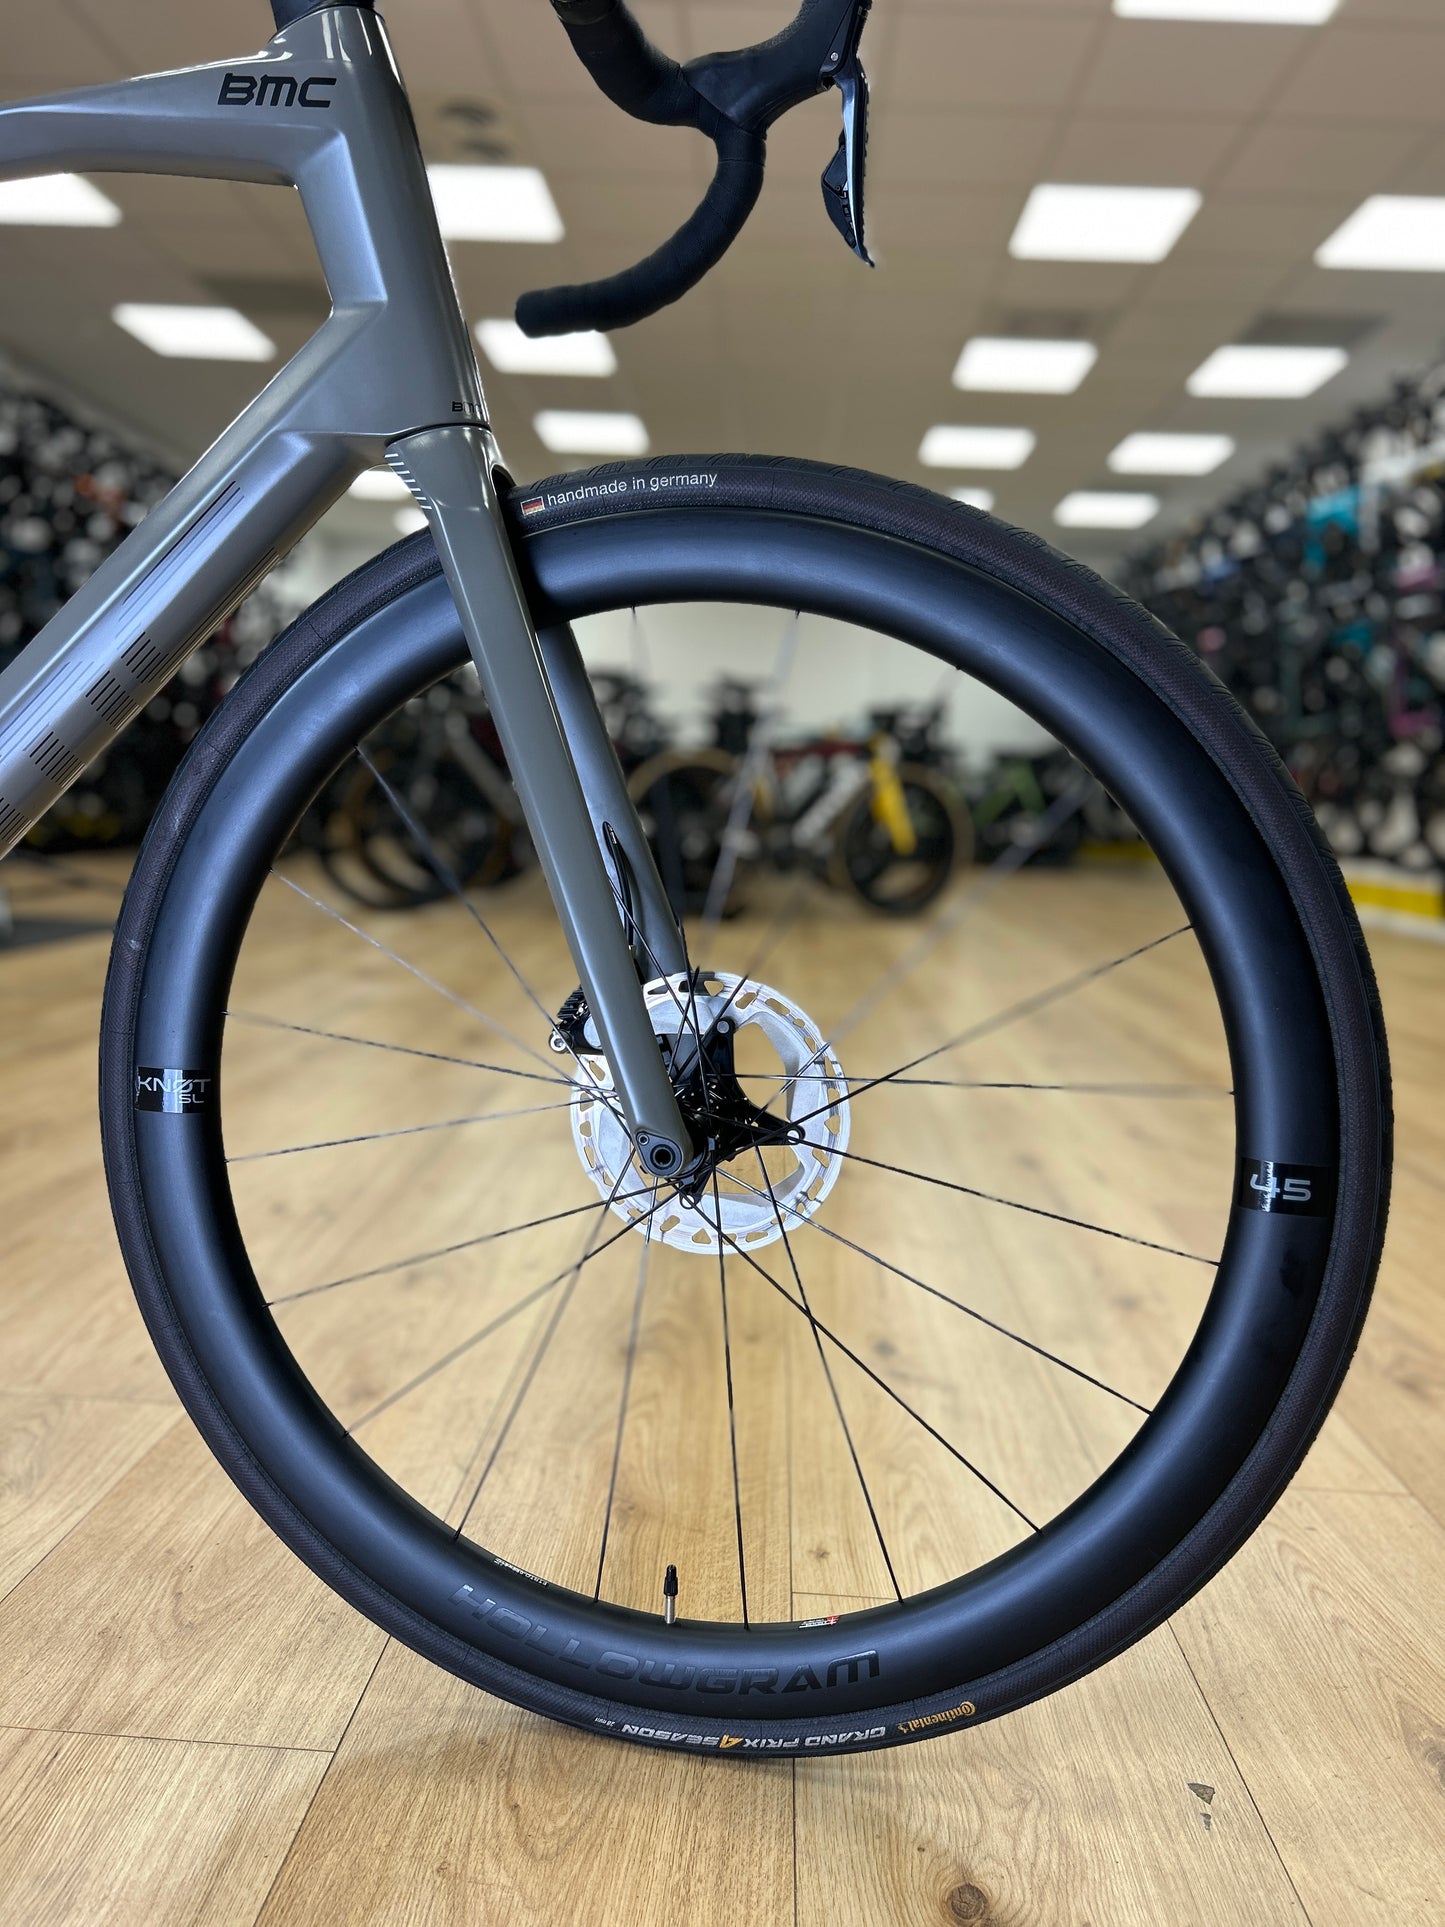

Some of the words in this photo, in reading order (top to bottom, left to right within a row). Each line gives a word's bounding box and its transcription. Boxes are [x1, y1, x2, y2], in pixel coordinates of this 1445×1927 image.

[217, 73, 337, 108] BMC
[547, 480, 628, 506] handmade
[632, 477, 646, 490] in
[650, 473, 718, 491] germany
[179, 1094, 205, 1104] SL
[1249, 1173, 1312, 1202] 45
[448, 1584, 881, 1695] HOLLOWGRAM
[907, 1701, 976, 1731] Continental
[804, 1726, 887, 1747] GRAND
